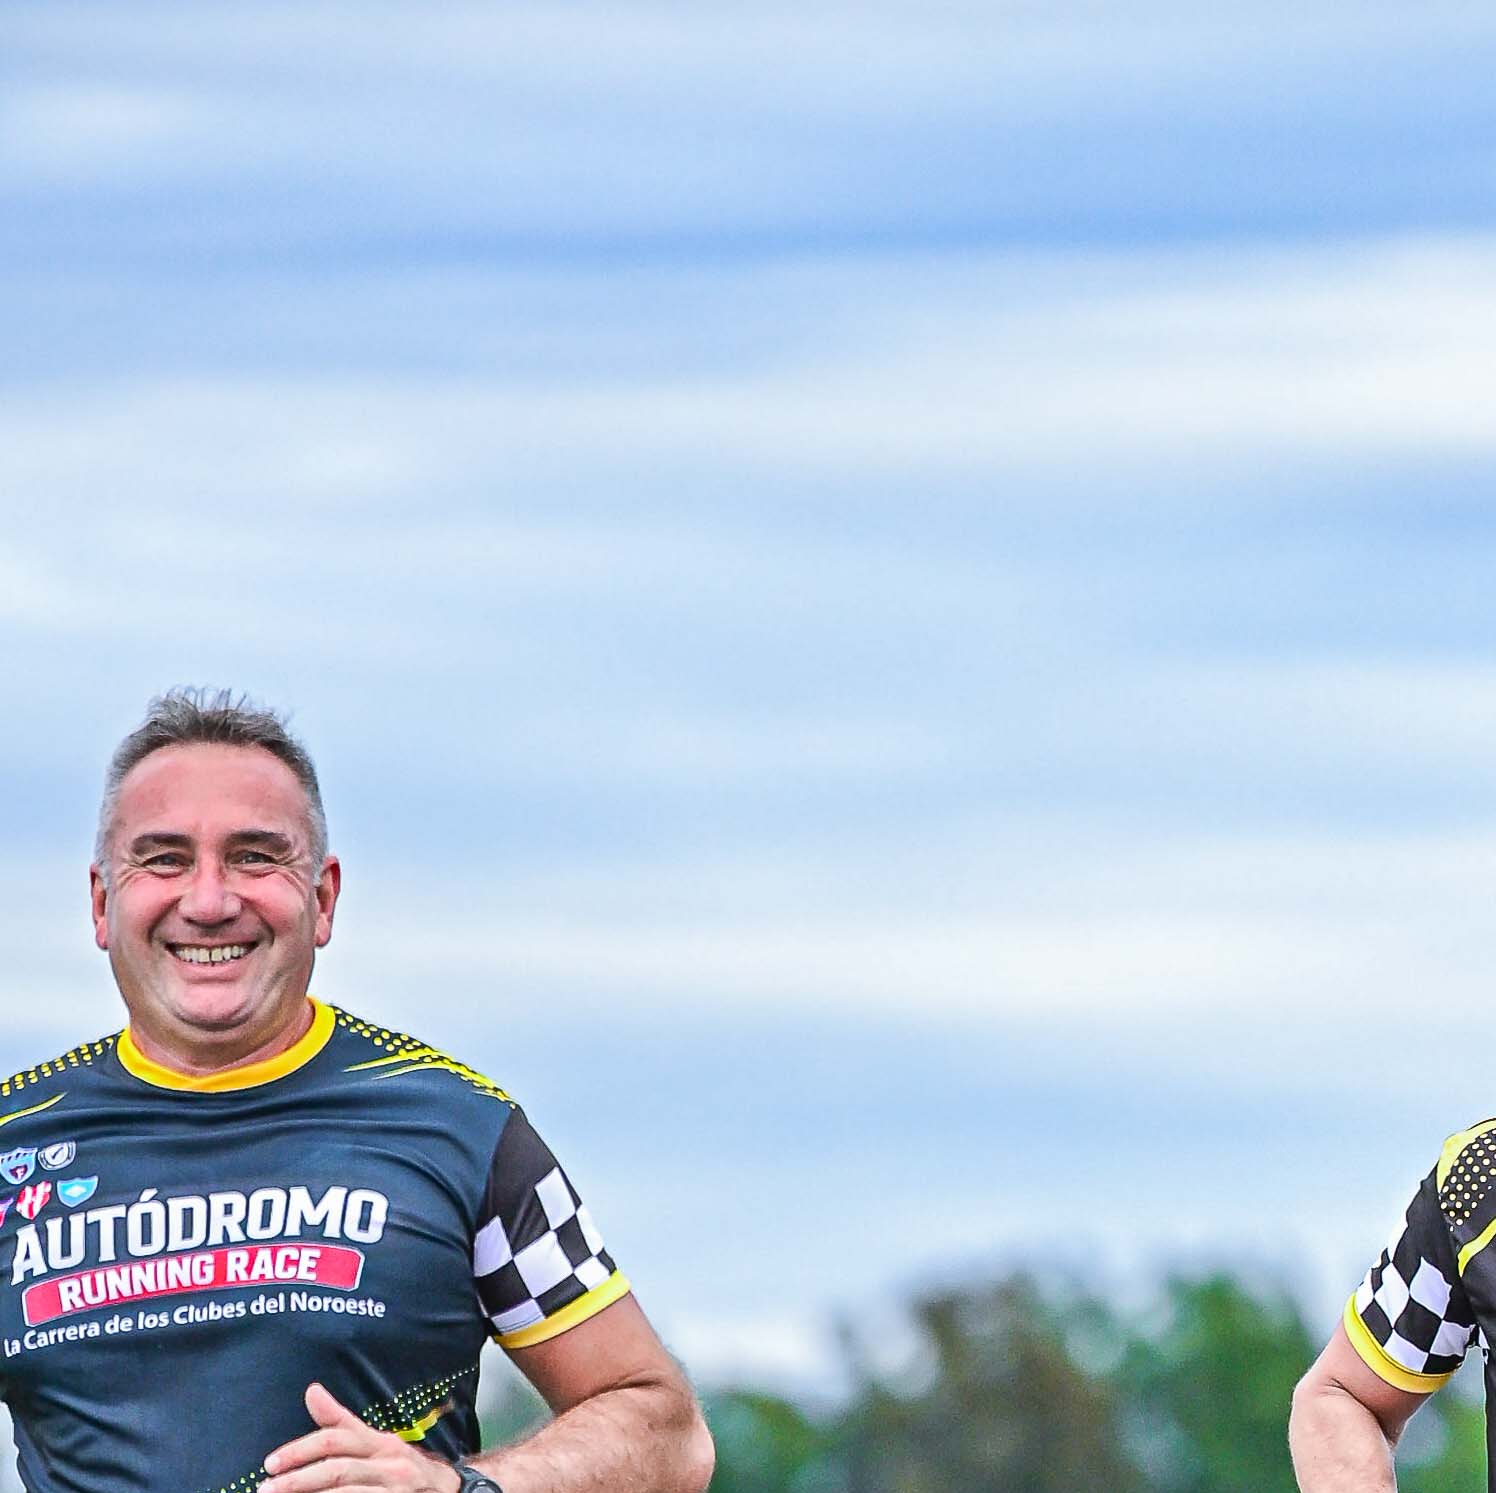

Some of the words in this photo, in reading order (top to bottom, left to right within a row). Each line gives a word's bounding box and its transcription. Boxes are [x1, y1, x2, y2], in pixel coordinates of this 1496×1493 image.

[10, 1185, 389, 1287] AUTÓDROMO
[57, 1254, 216, 1314] RUNNING
[225, 1248, 323, 1282] RACE
[4, 1337, 21, 1358] La
[23, 1320, 101, 1351] Carrera
[104, 1313, 134, 1336] de
[137, 1309, 171, 1331] los
[173, 1300, 247, 1326] Clubes
[250, 1293, 286, 1315] del
[290, 1292, 387, 1319] Noroeste
